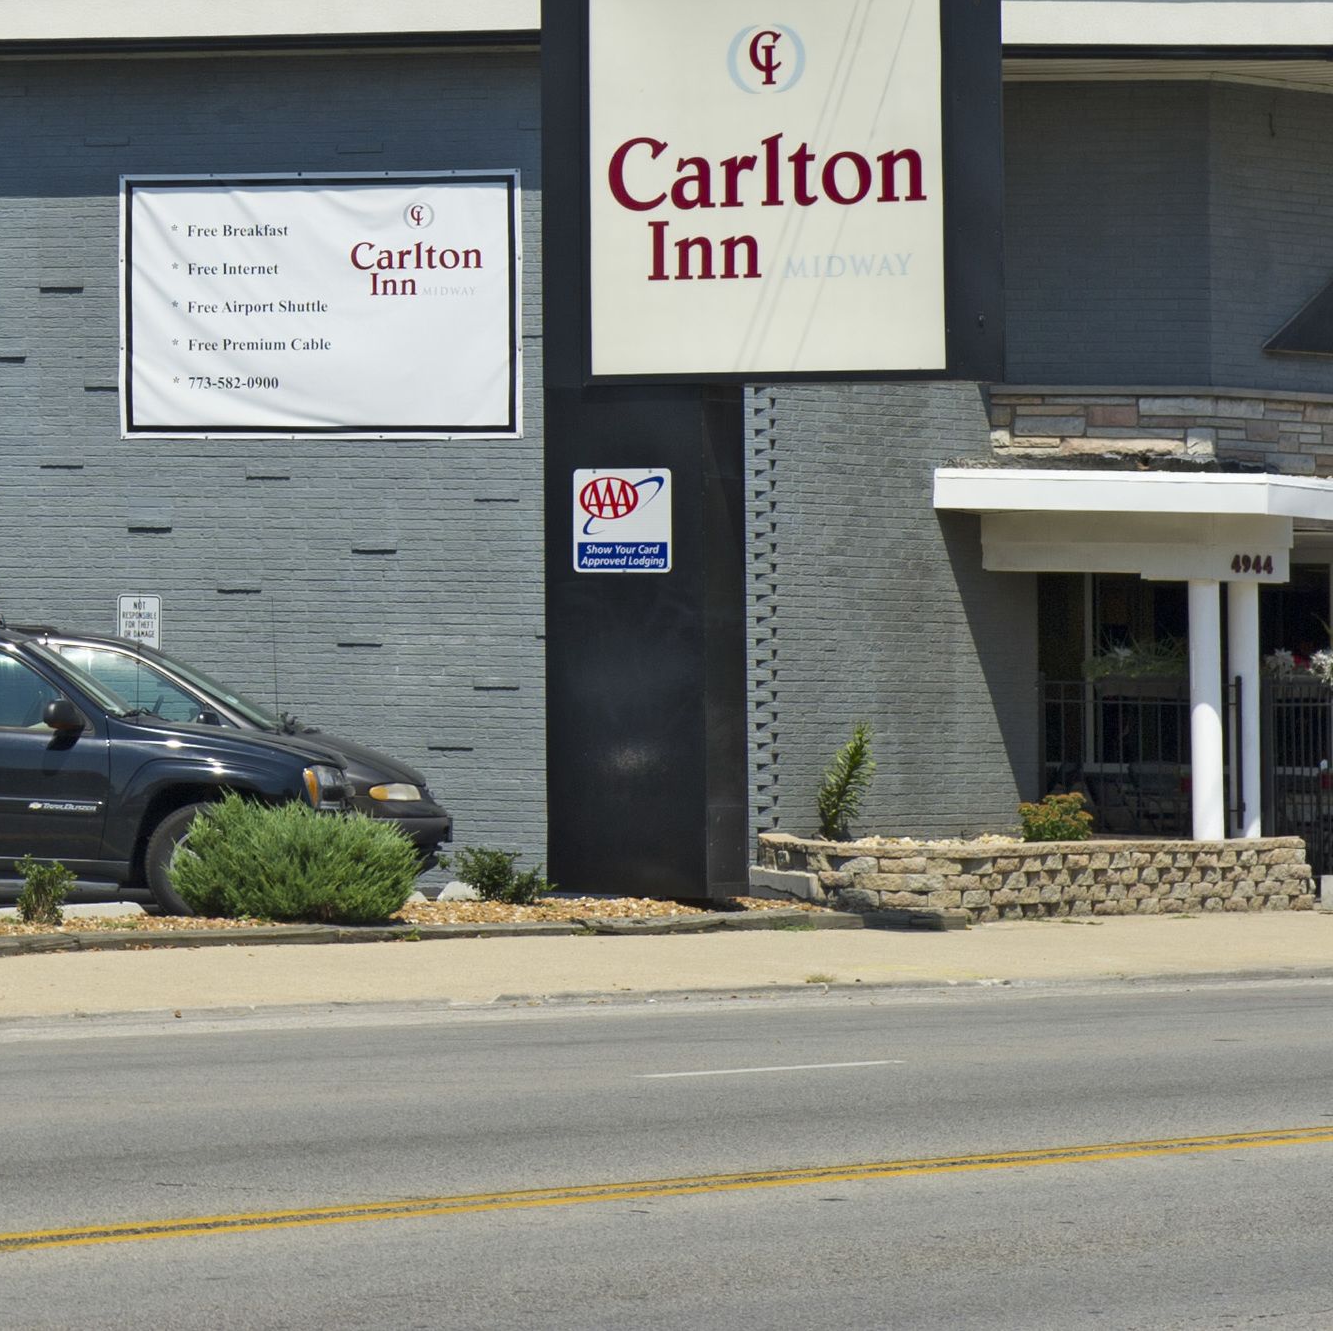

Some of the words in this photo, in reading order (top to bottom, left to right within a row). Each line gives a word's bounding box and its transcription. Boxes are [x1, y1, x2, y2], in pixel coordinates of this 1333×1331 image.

[607, 132, 928, 211] Carlton
[186, 223, 219, 238] Free
[221, 223, 289, 238] Breakfast
[349, 241, 484, 272] Carlton
[647, 220, 763, 281] Inn
[783, 252, 914, 279] MIDWAY
[187, 262, 219, 276] Free
[221, 262, 279, 276] Internet
[369, 272, 418, 297] Inn
[421, 285, 477, 297] MIDWAY
[187, 300, 219, 314] Free
[221, 300, 275, 317] Airport
[277, 299, 329, 315] Shuttle
[187, 338, 219, 352] Free
[221, 338, 287, 352] Premium
[290, 337, 332, 352] Cable
[187, 376, 280, 391] 773-582-0900
[583, 478, 635, 518] AAA
[586, 544, 612, 554] Show
[615, 544, 636, 554] Your
[638, 544, 659, 554] Card
[581, 555, 627, 568] Approved
[628, 555, 665, 568] Lodging
[1230, 553, 1274, 575] 4944
[133, 601, 146, 609] NOT
[122, 611, 157, 619] RESPONSIBLE
[125, 620, 135, 628] FOR
[137, 620, 153, 628] THEFT
[133, 629, 155, 637] DAMAGE
